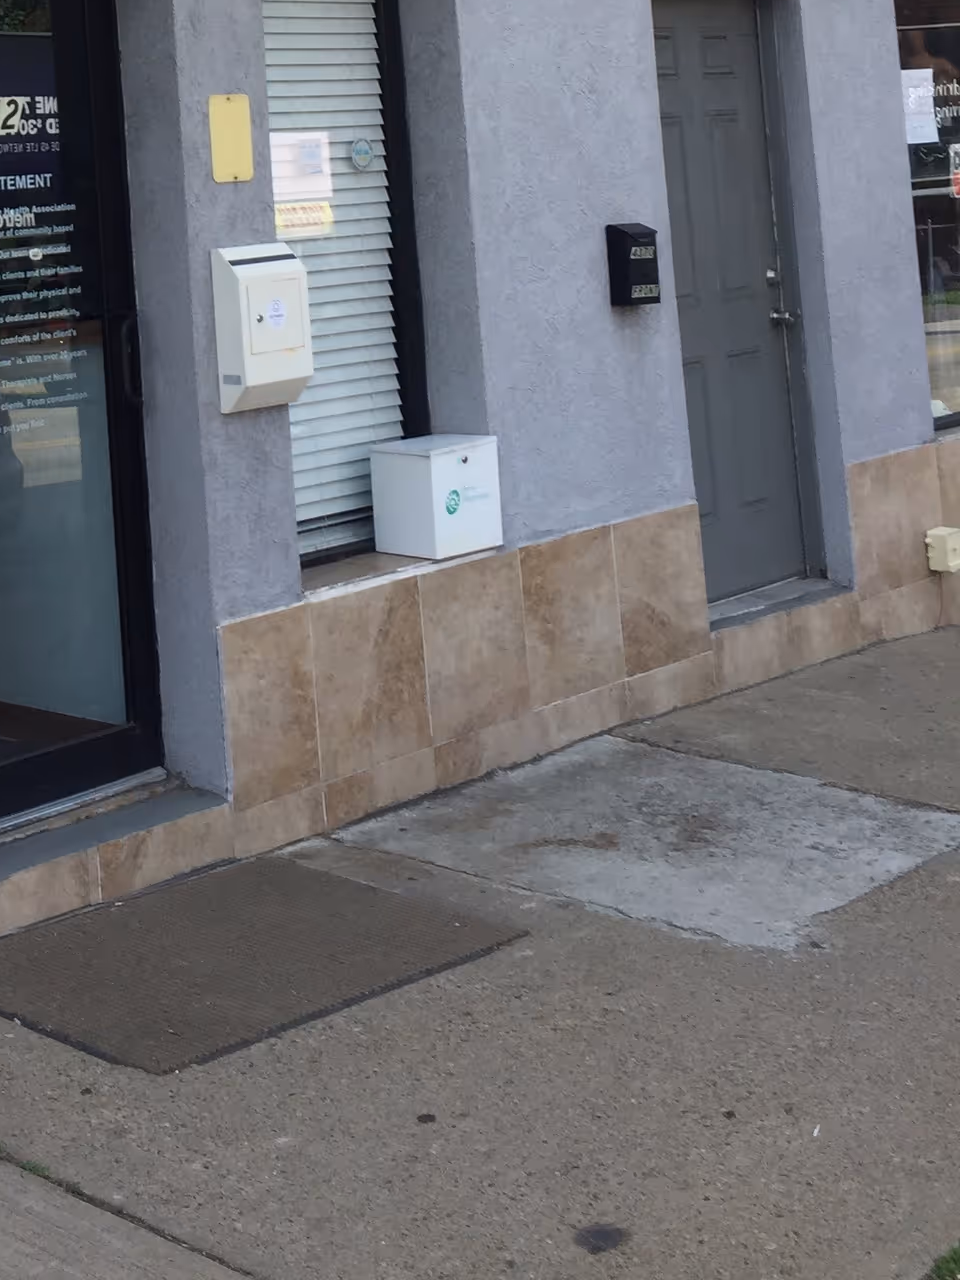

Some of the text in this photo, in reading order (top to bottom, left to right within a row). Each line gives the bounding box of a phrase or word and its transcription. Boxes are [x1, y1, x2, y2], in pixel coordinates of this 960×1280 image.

[32, 203, 77, 214] Association
[15, 224, 53, 235] community
[53, 223, 74, 233] based
[26, 269, 40, 278] and
[22, 290, 38, 299] their
[39, 287, 68, 300] physical
[68, 285, 82, 295] and
[5, 312, 39, 323] dedicated
[40, 311, 48, 319] to
[0, 334, 32, 345] comforts
[32, 331, 40, 341] of
[40, 331, 52, 340] the
